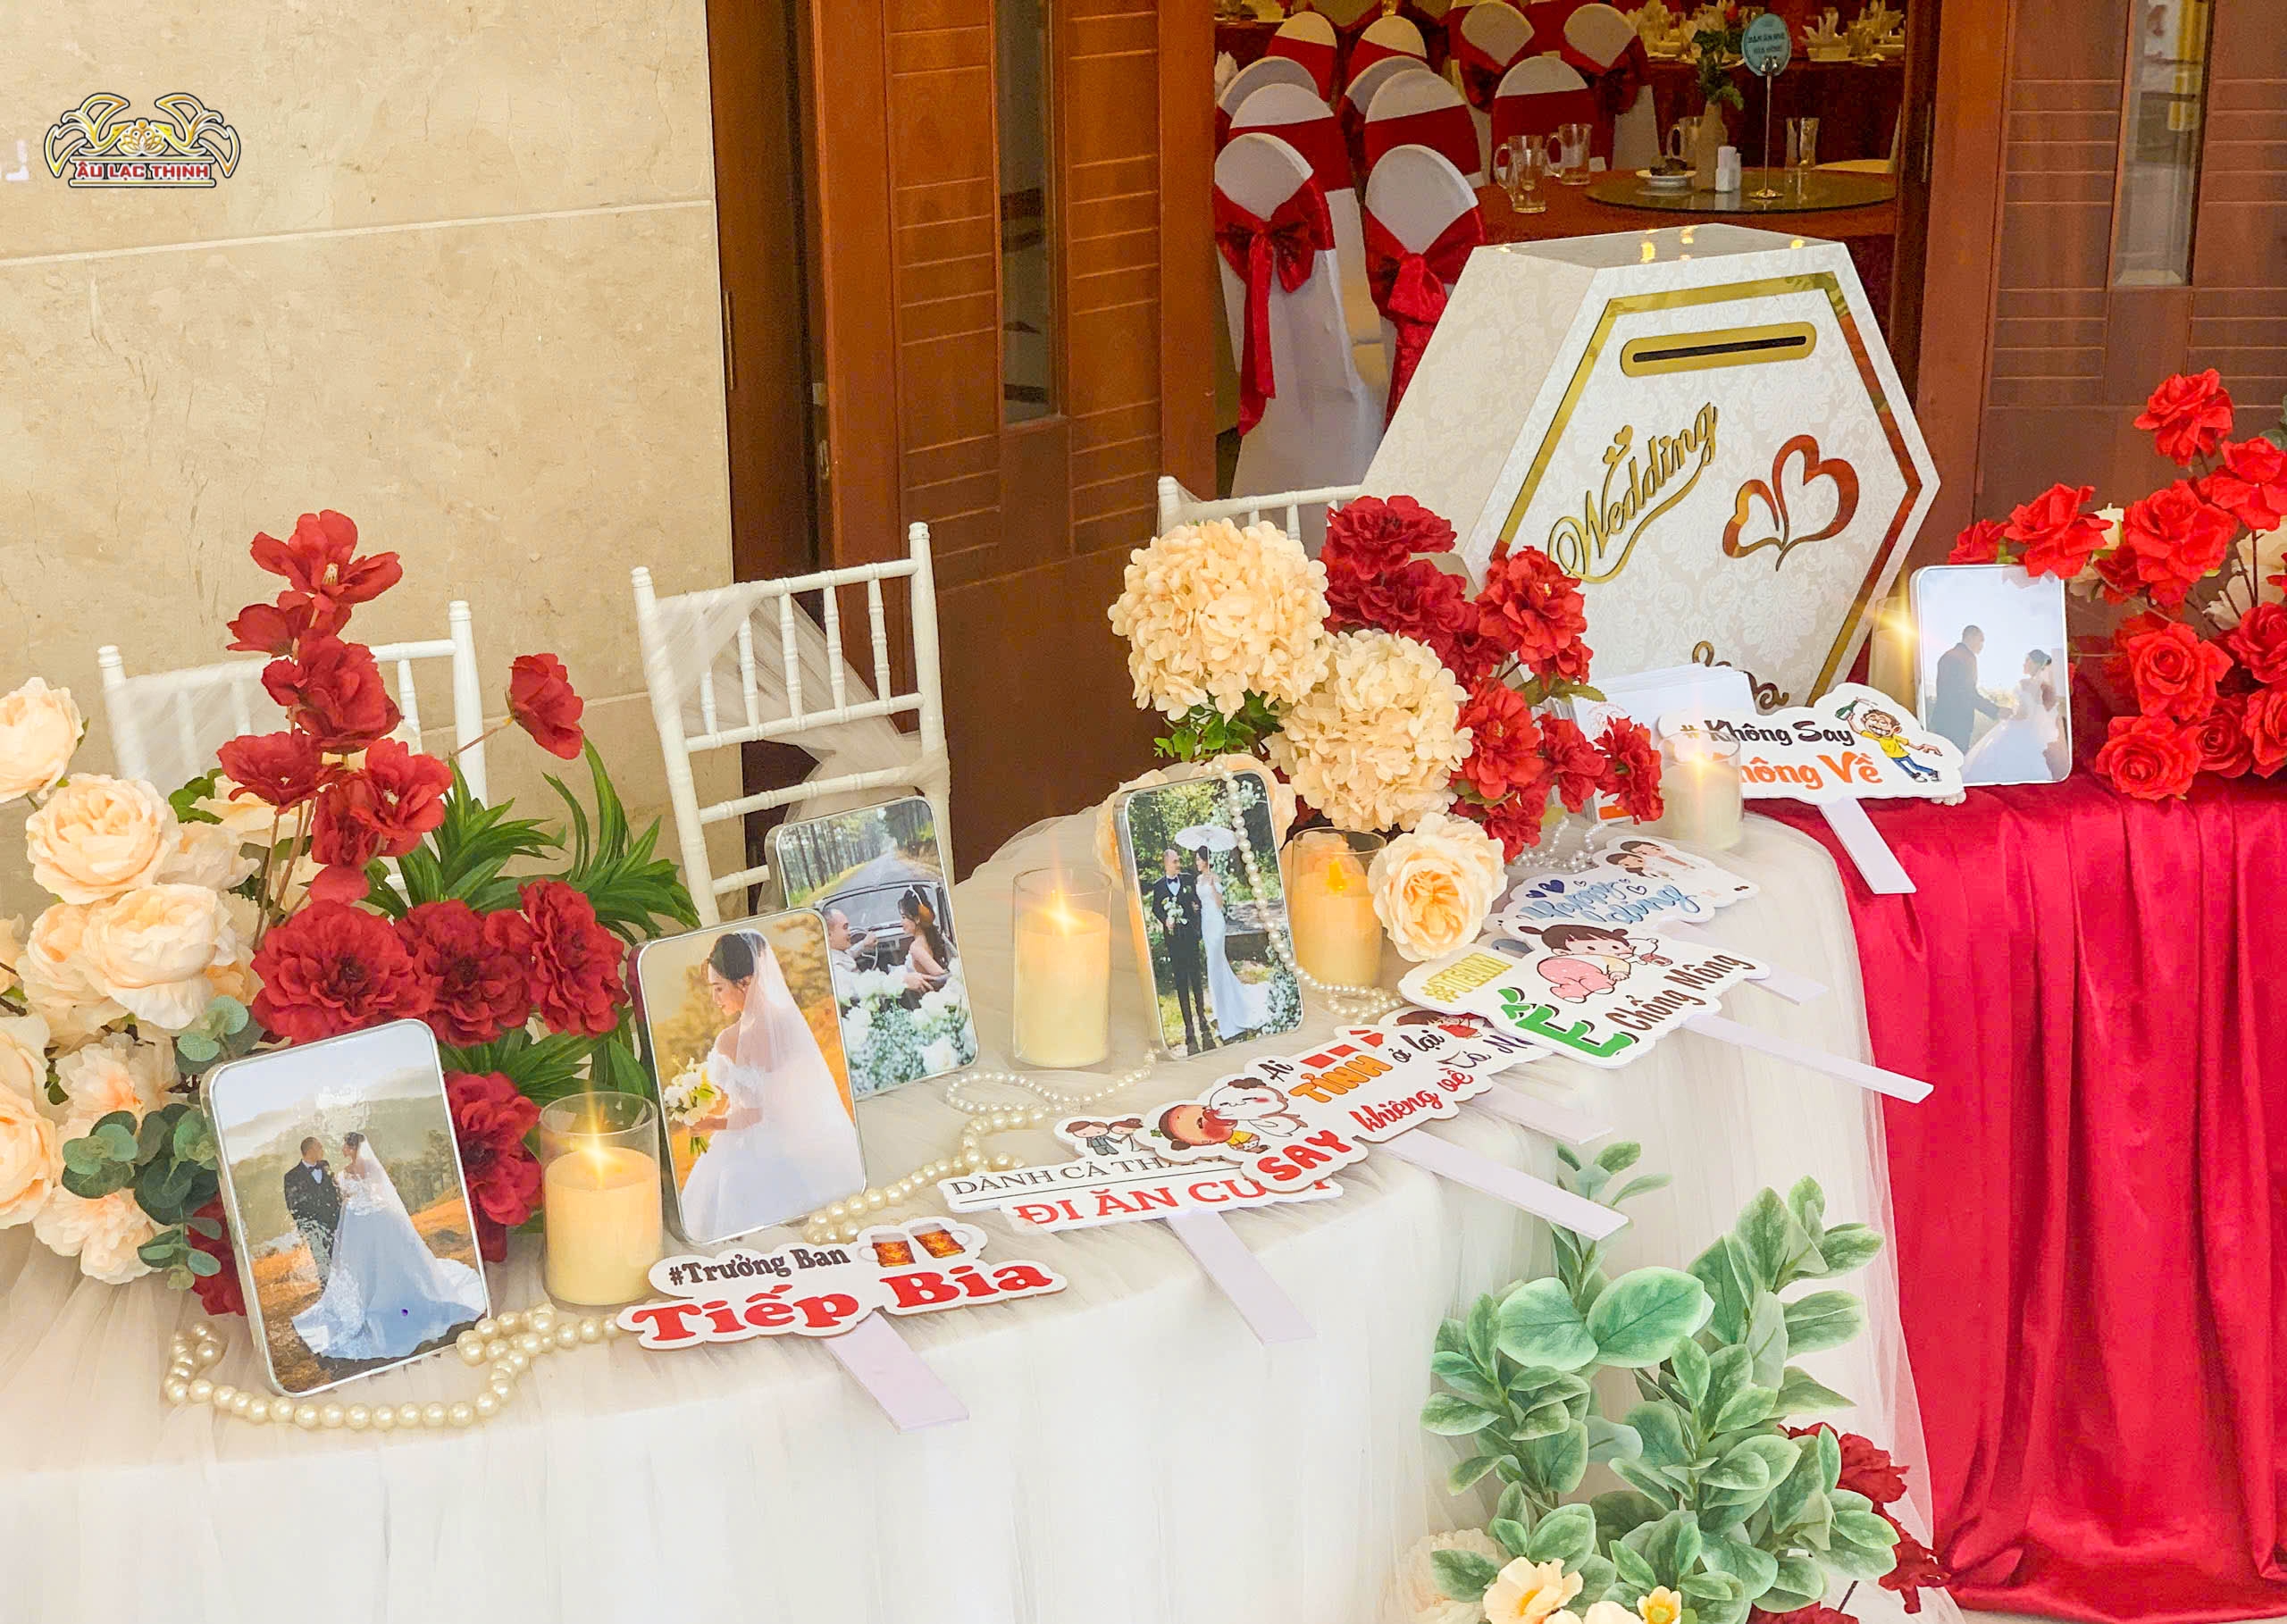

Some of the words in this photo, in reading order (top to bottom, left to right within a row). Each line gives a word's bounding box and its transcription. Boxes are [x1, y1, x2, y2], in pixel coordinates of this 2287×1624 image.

[1547, 402, 1718, 583] Wedding
[1704, 720, 1793, 747] Không
[1792, 720, 1856, 747] Say
[1816, 751, 1883, 784] Về
[1605, 992, 1706, 1031] Chổng
[1663, 954, 1756, 991] Mông
[1258, 1059, 1294, 1083] Ai
[1288, 1055, 1394, 1103] TỈNH
[1400, 1030, 1445, 1051] lại
[1257, 1130, 1353, 1181] SAY
[1349, 1090, 1443, 1132] khiêng
[1437, 1068, 1474, 1092] về
[949, 1170, 1056, 1194] DÀNH
[1060, 1160, 1110, 1179] CẢ
[1012, 1200, 1084, 1225] ĐI
[1089, 1187, 1179, 1217] ĂN
[669, 1253, 792, 1286] #Trưởng
[790, 1248, 851, 1269] Ban
[632, 1284, 859, 1341] Tiếp
[879, 1265, 1053, 1308] Bia
